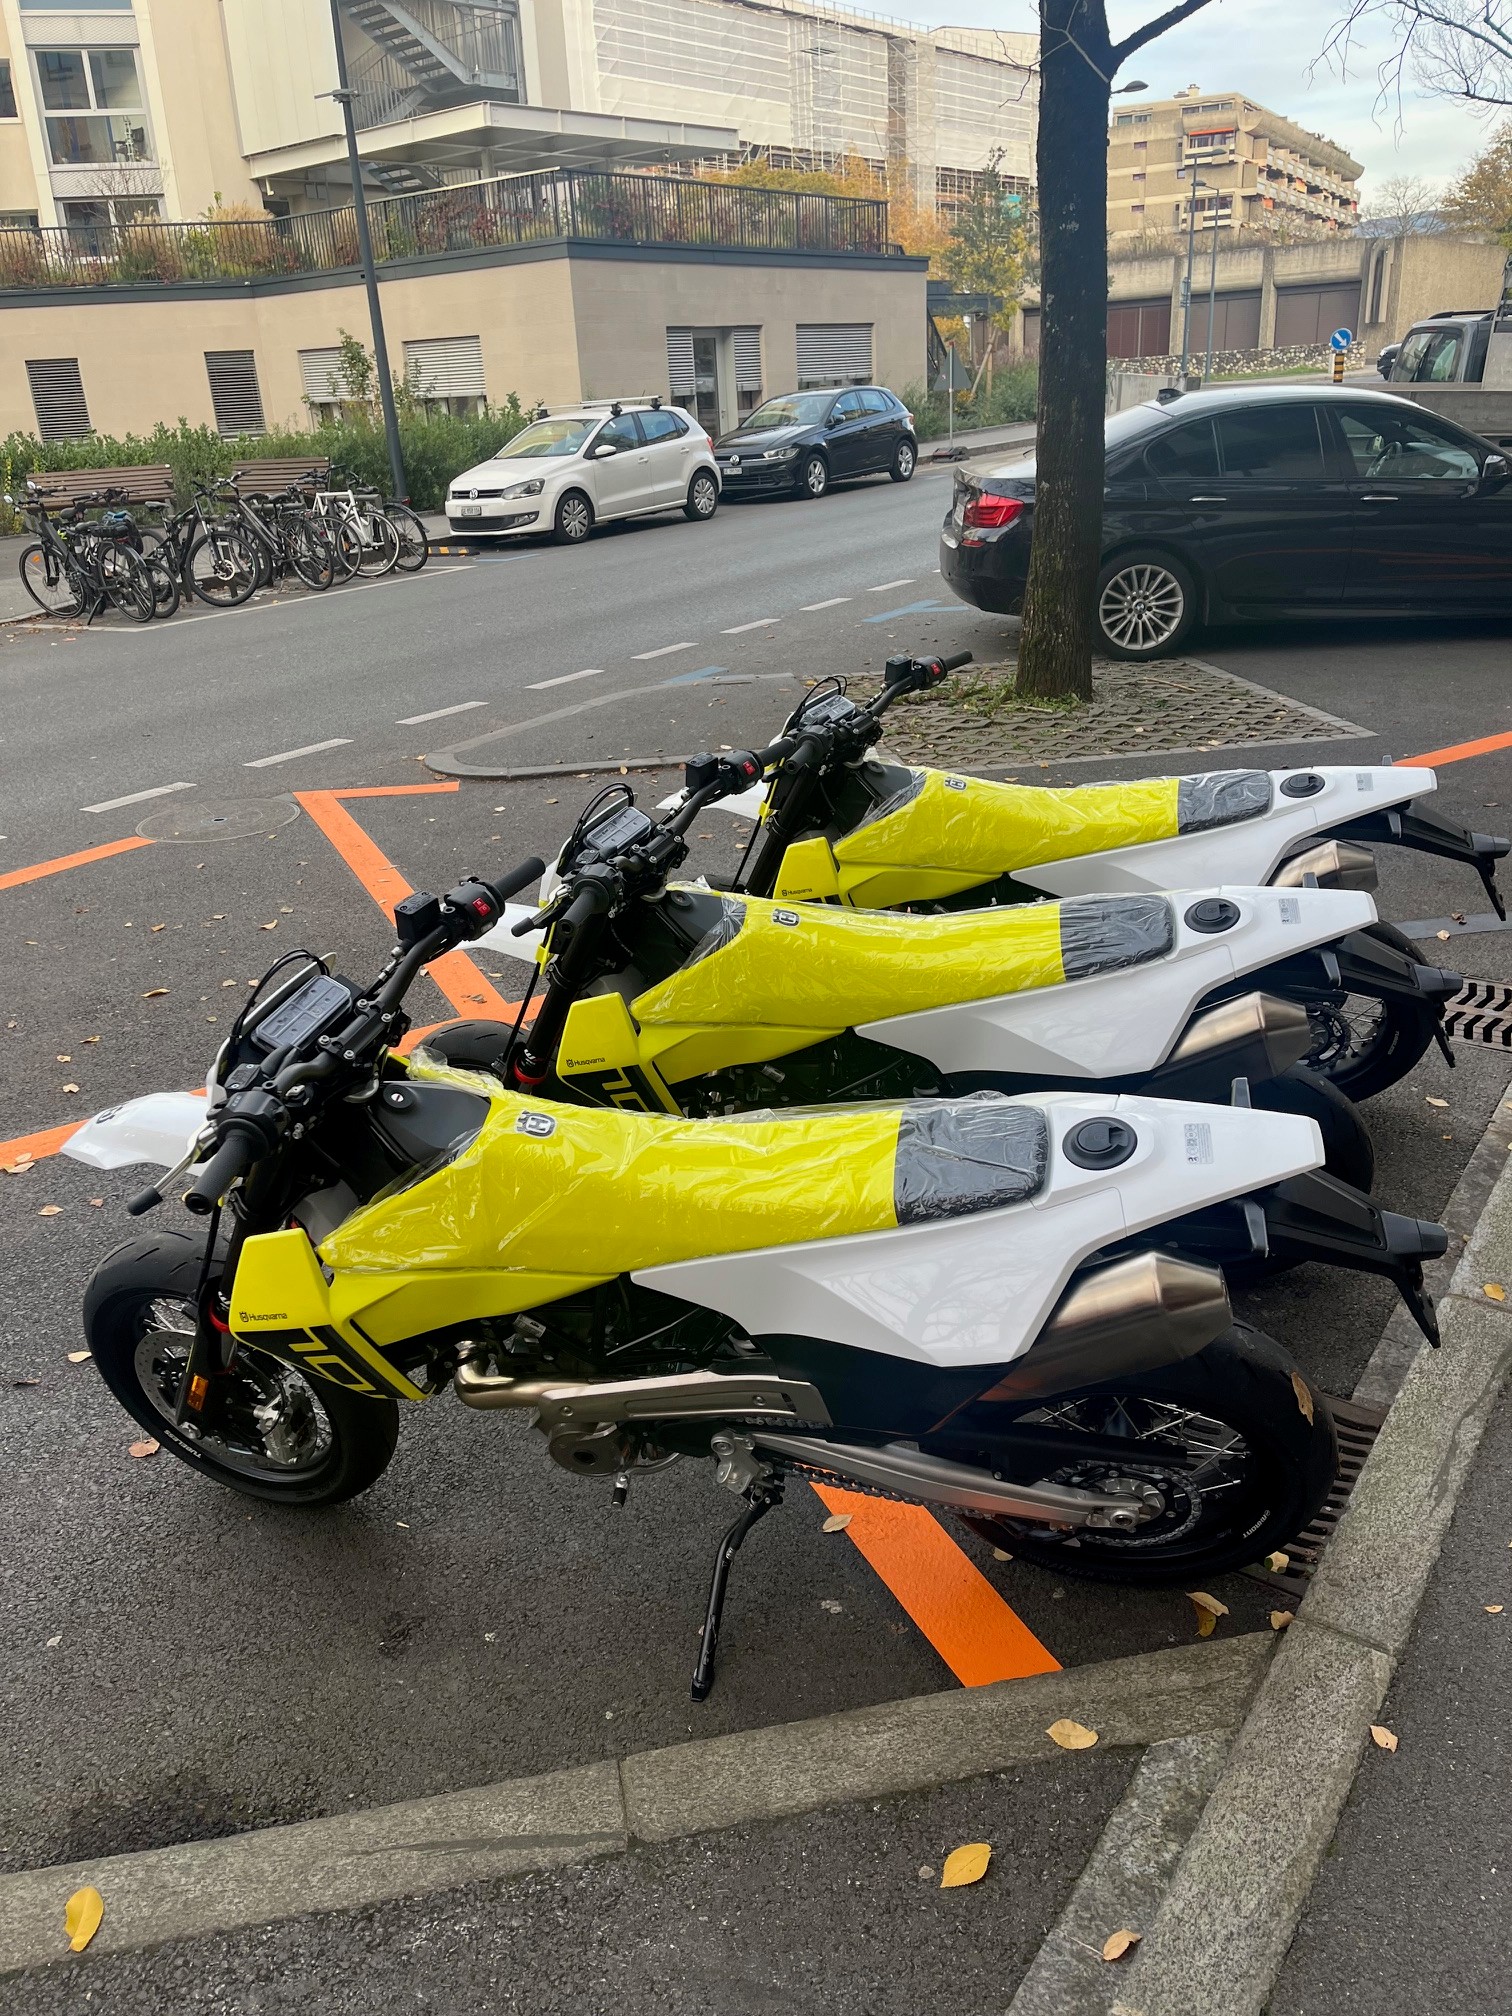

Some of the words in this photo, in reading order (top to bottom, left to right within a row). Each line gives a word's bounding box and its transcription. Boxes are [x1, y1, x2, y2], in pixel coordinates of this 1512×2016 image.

[574, 1057, 606, 1066] Husqvarna
[249, 1312, 288, 1322] Husqvarna
[164, 1429, 202, 1459] TUBELESS
